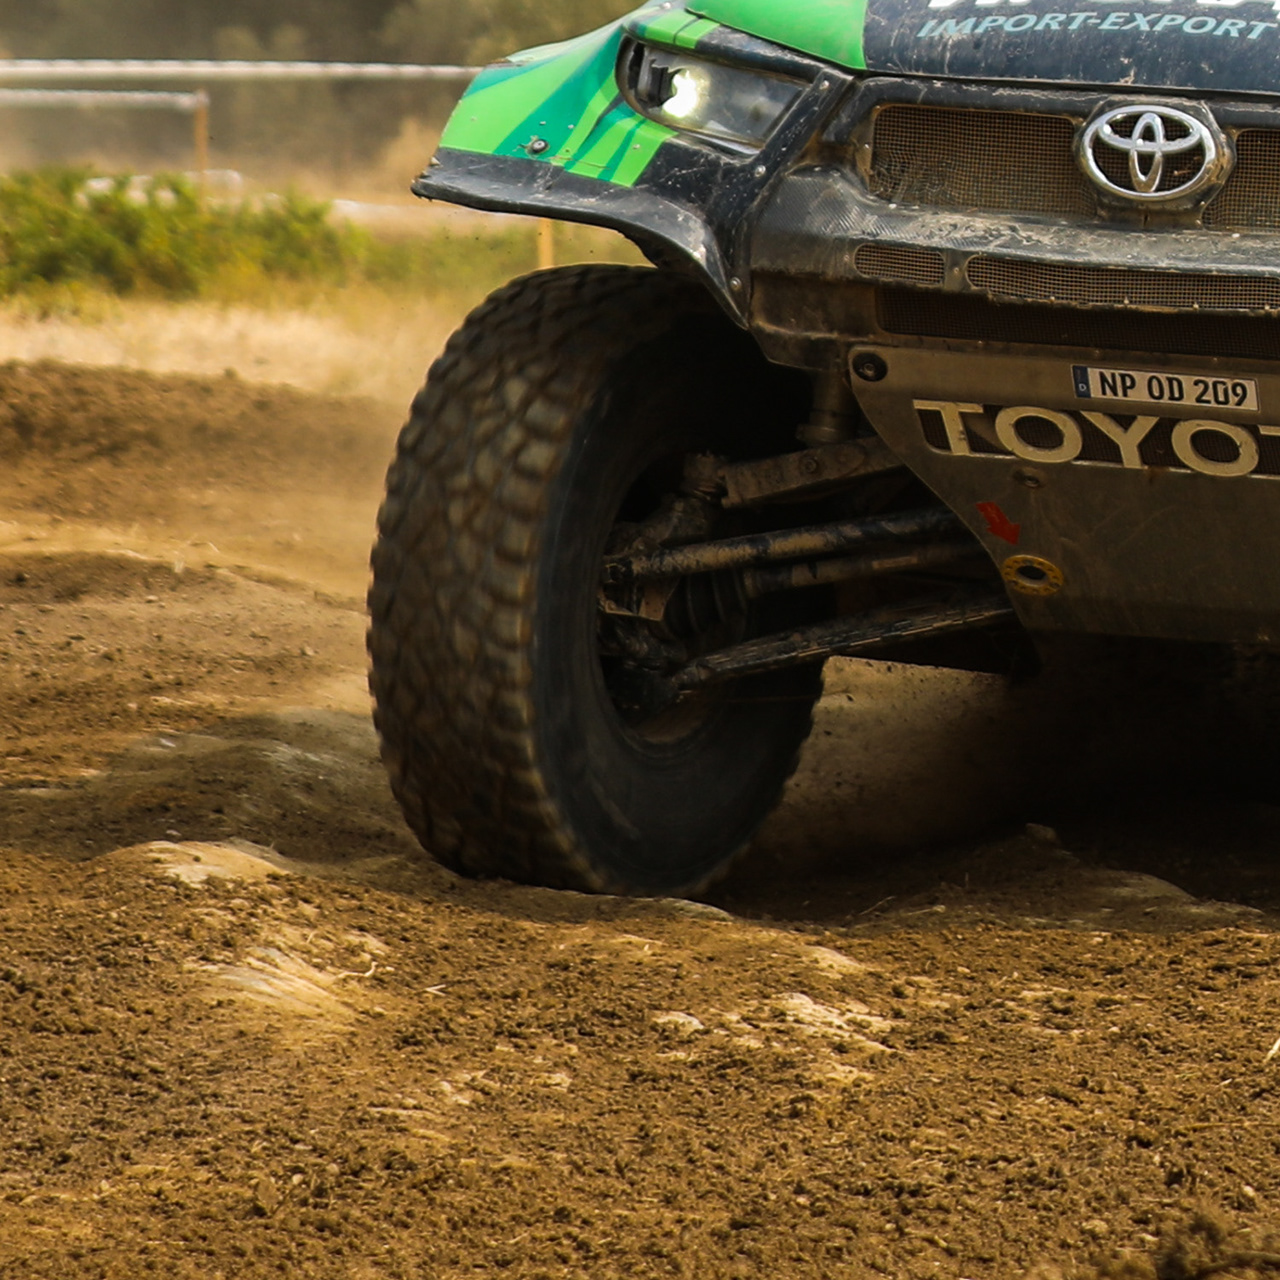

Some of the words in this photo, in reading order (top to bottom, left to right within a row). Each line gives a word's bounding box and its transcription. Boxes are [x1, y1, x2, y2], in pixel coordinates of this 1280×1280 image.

[917, 12, 1278, 39] IMPORT-EXPORT
[1099, 371, 1136, 398] NP
[1147, 375, 1184, 401] OD
[1193, 379, 1248, 407] 209
